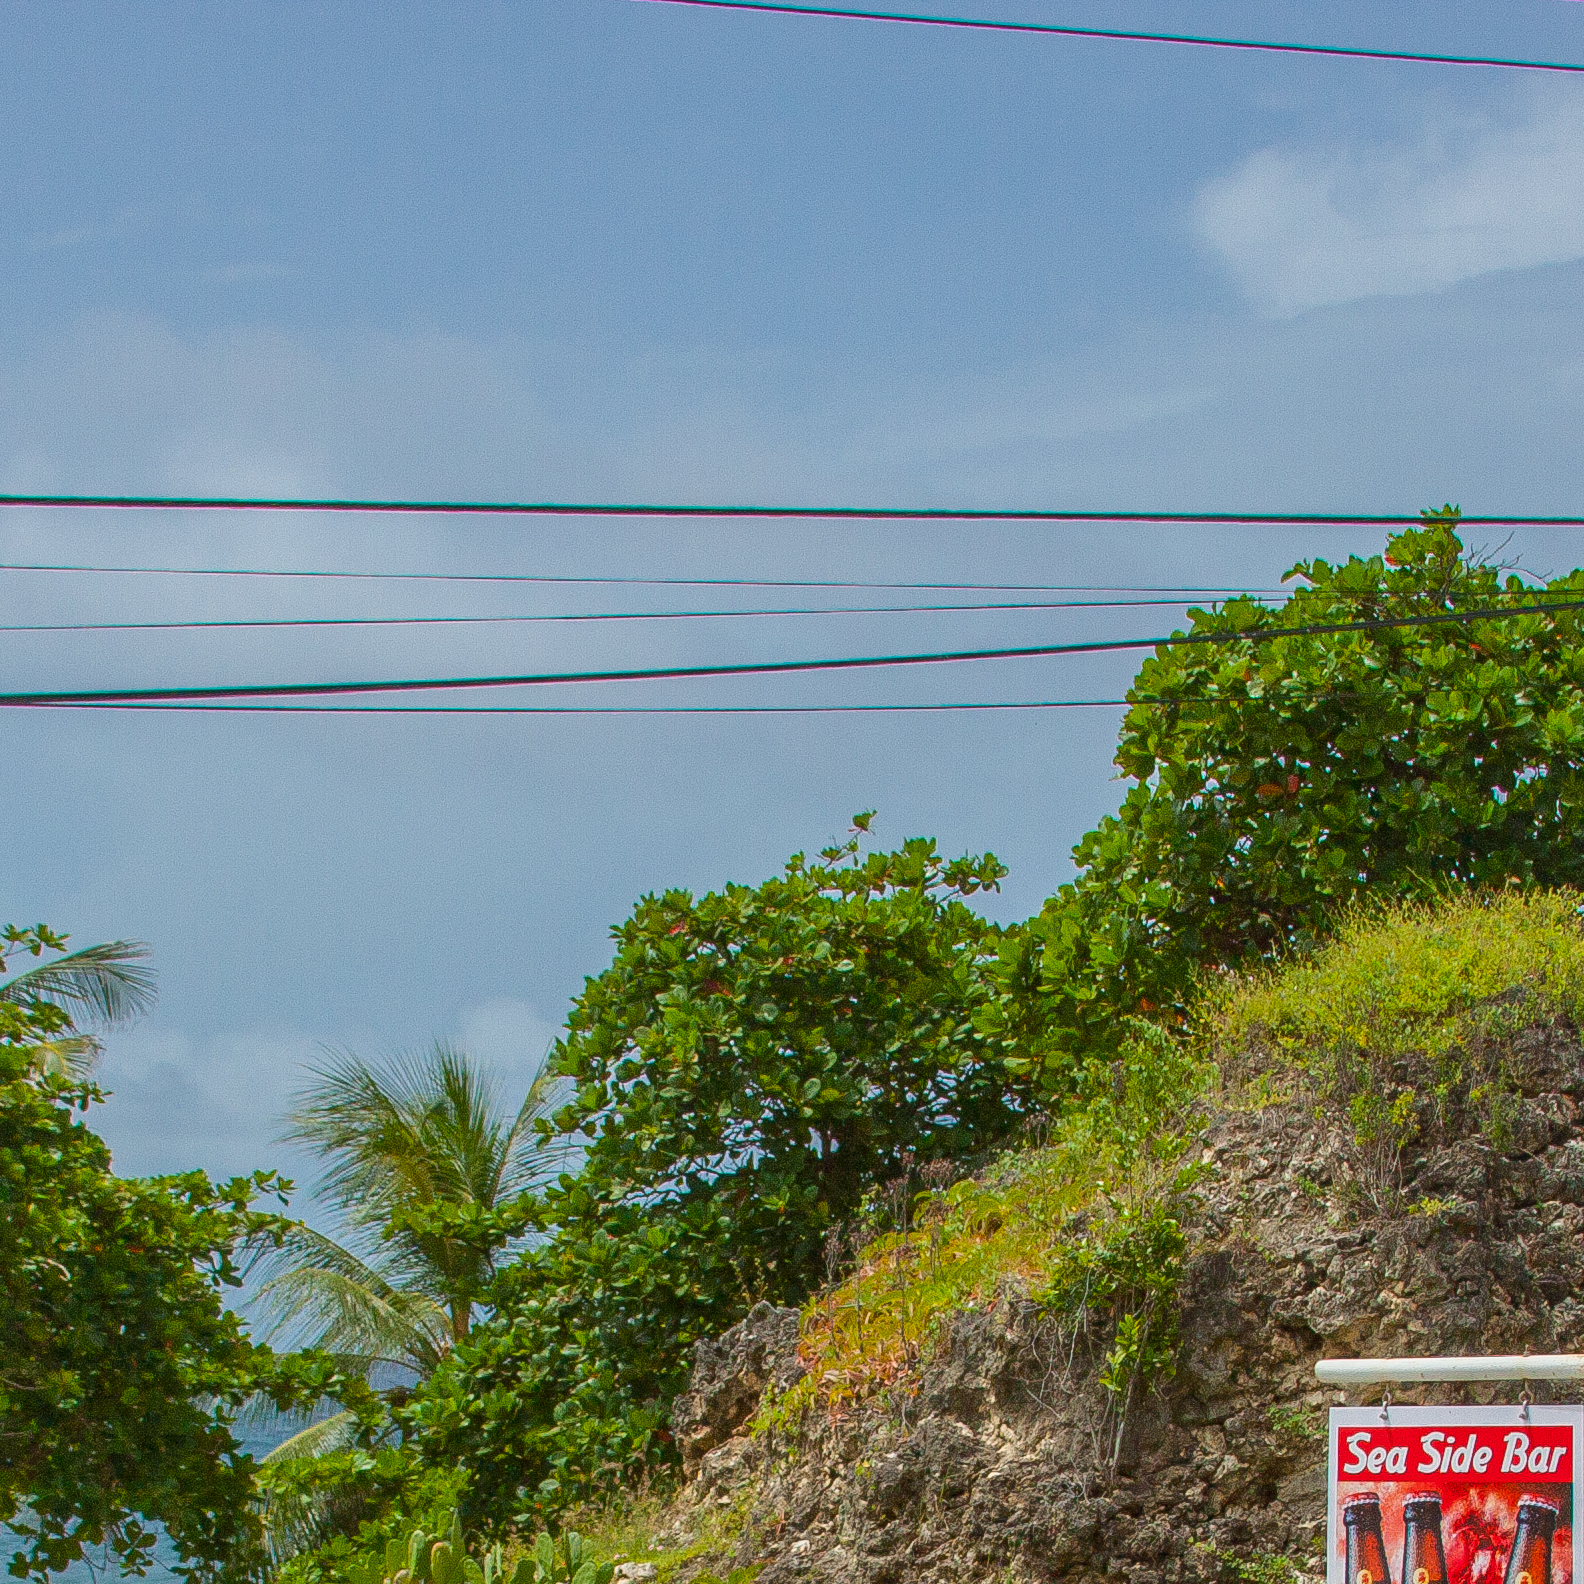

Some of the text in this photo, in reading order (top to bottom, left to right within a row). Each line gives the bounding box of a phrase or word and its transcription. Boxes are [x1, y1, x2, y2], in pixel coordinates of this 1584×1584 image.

[1343, 1431, 1567, 1474] Sea Side Bar
